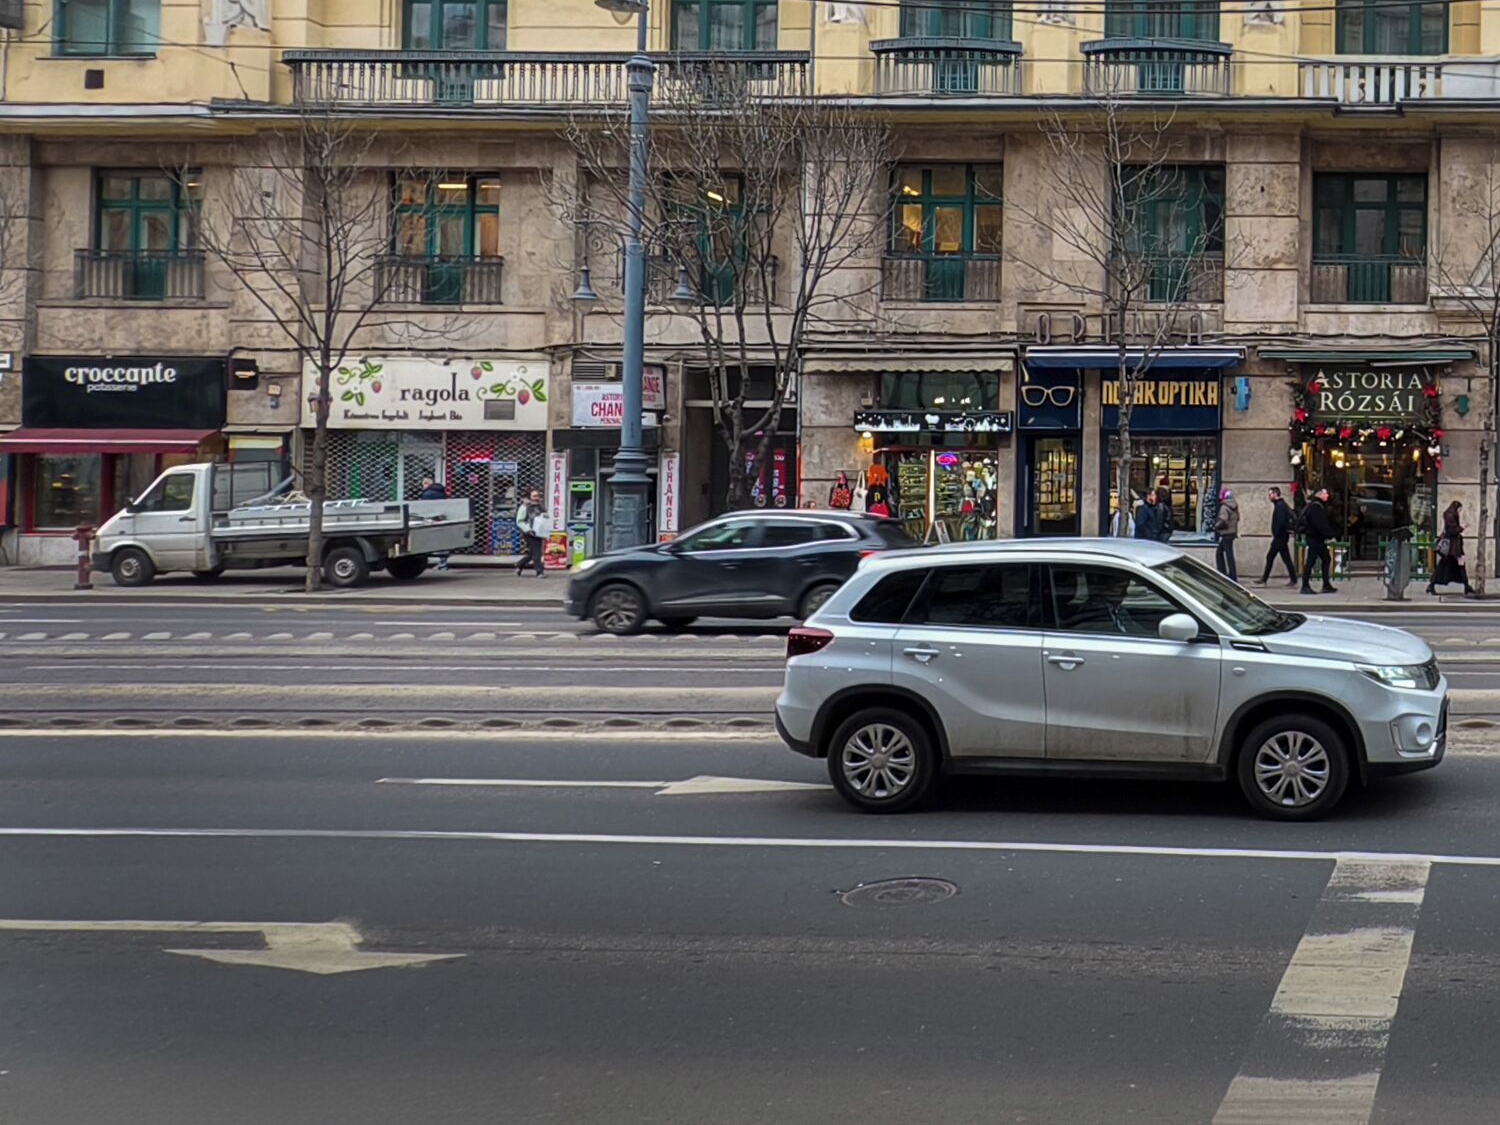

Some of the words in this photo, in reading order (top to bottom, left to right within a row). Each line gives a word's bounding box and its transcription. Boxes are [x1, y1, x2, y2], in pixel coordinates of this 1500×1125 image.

[64, 362, 176, 385] croccante
[1314, 369, 1423, 389] ASTORIA
[1158, 381, 1218, 406] OPTIKA
[1318, 391, 1415, 412] RÓZSÁI
[591, 402, 622, 417] CHAN
[553, 459, 561, 530] CHANGE
[664, 459, 673, 530] CHANGE
